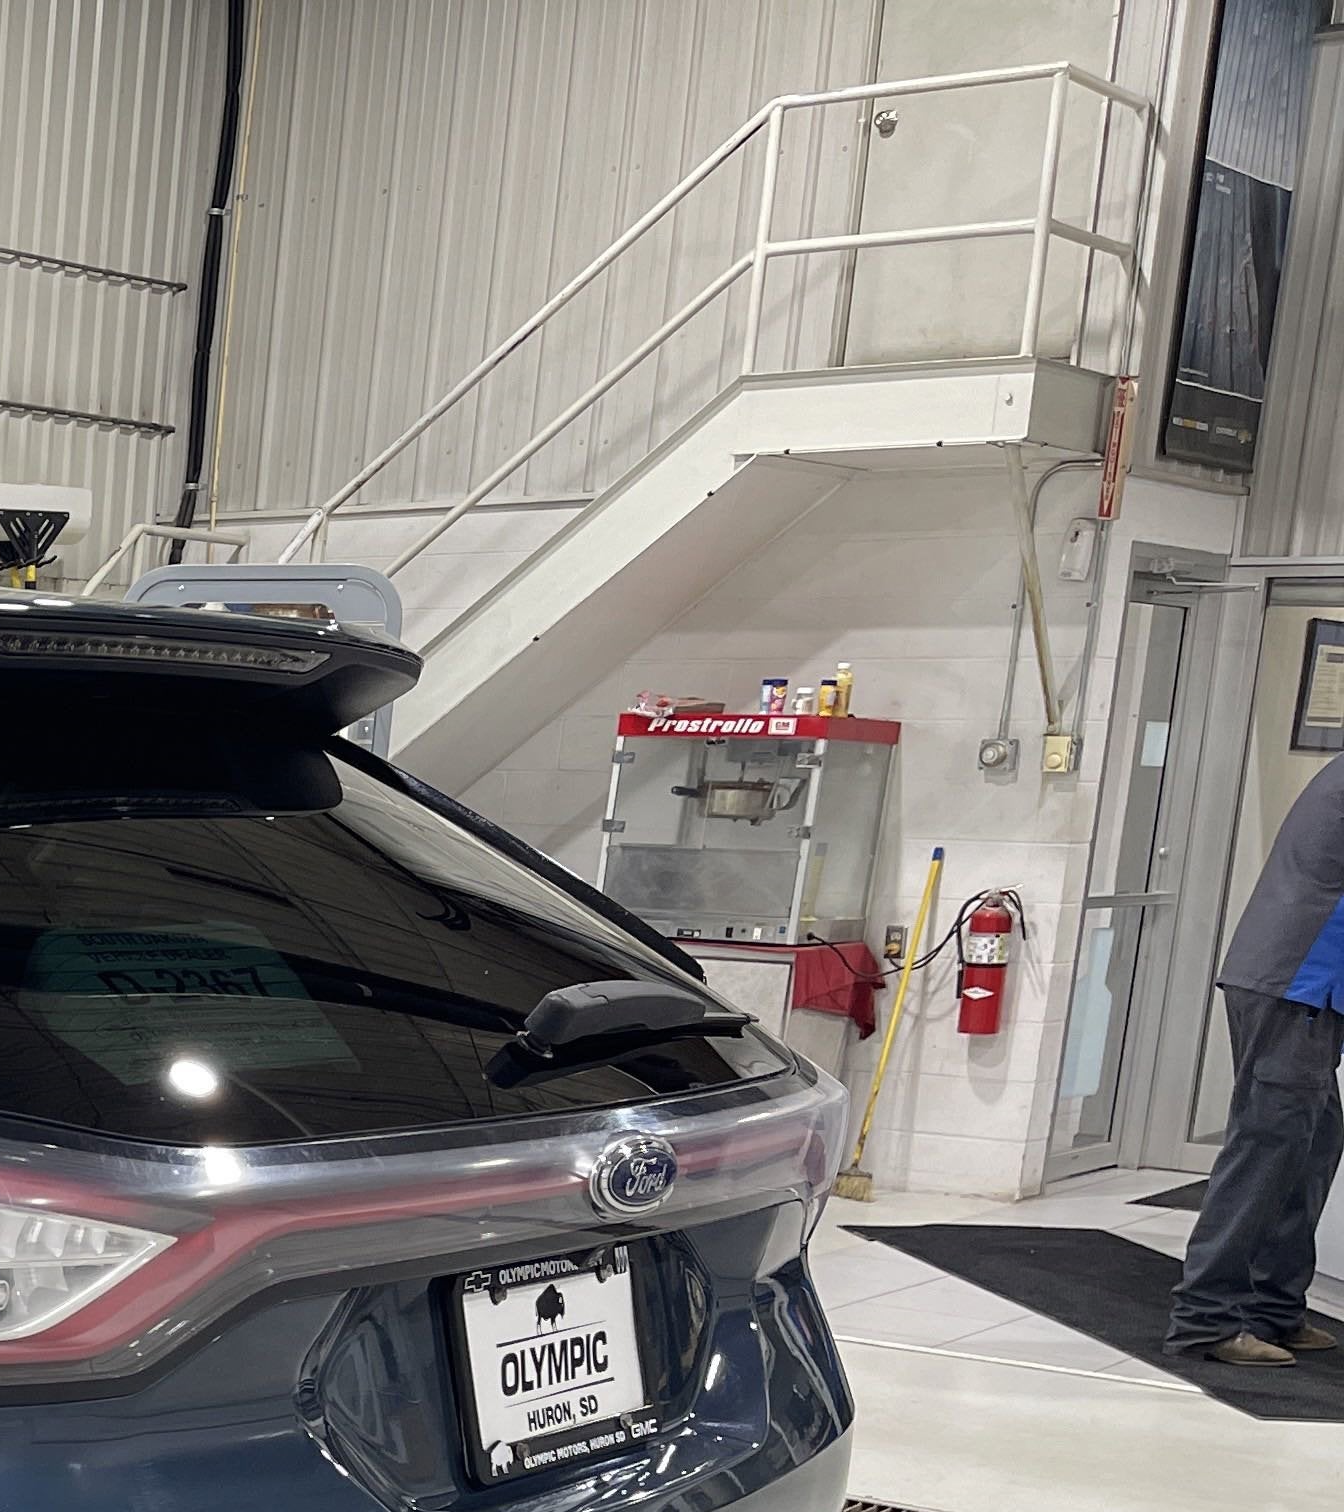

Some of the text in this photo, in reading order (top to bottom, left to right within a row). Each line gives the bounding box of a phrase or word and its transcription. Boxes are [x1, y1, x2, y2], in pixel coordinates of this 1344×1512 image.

[647, 717, 765, 734] Prostrollo
[625, 1156, 668, 1197] Ford
[501, 1330, 608, 1397] OLYMPIC
[527, 1394, 599, 1432] HURON, SD
[630, 1418, 658, 1438] GMC
[523, 1430, 626, 1469] OLYMPIC MOTORS, HURON SD
